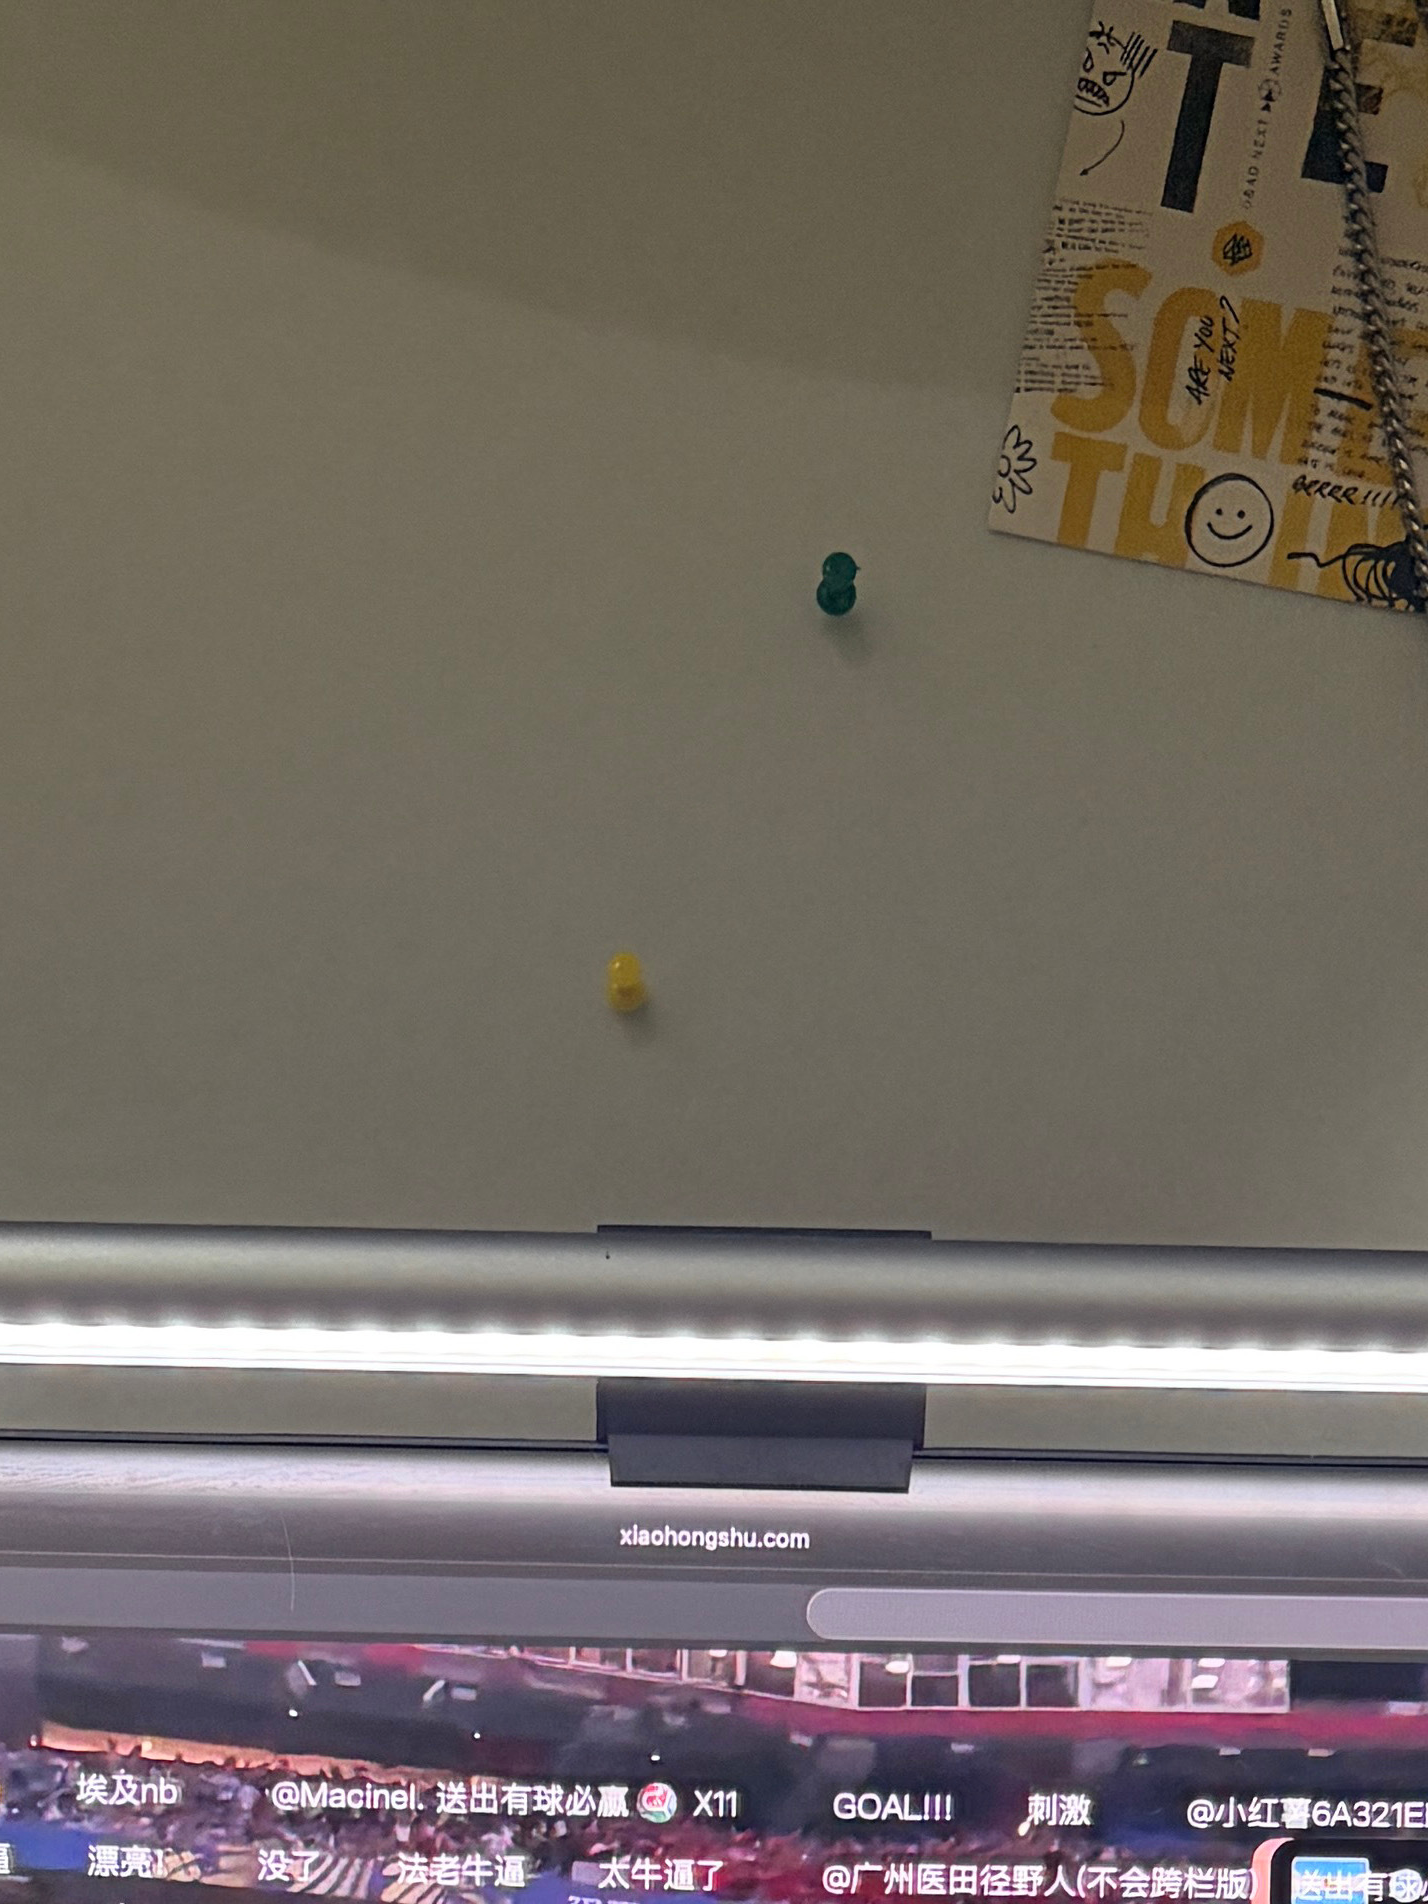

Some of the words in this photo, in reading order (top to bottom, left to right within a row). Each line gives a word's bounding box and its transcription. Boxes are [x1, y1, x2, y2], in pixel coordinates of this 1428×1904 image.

[1269, 7, 1293, 77] AWARDS
[1182, 359, 1212, 406] ARE
[619, 1525, 810, 1552] xiaohongshu.com
[75, 1771, 177, 1806] 埃及nb
[436, 1783, 629, 1818] 送出有球必赢
[693, 1790, 738, 1818] X11
[833, 1793, 952, 1824] GOAL!!!
[1027, 1793, 1091, 1828] 刺激
[258, 1848, 320, 1884] 没了
[397, 1853, 525, 1889] 法老牛逼
[599, 1858, 723, 1892] 太牛逼了
